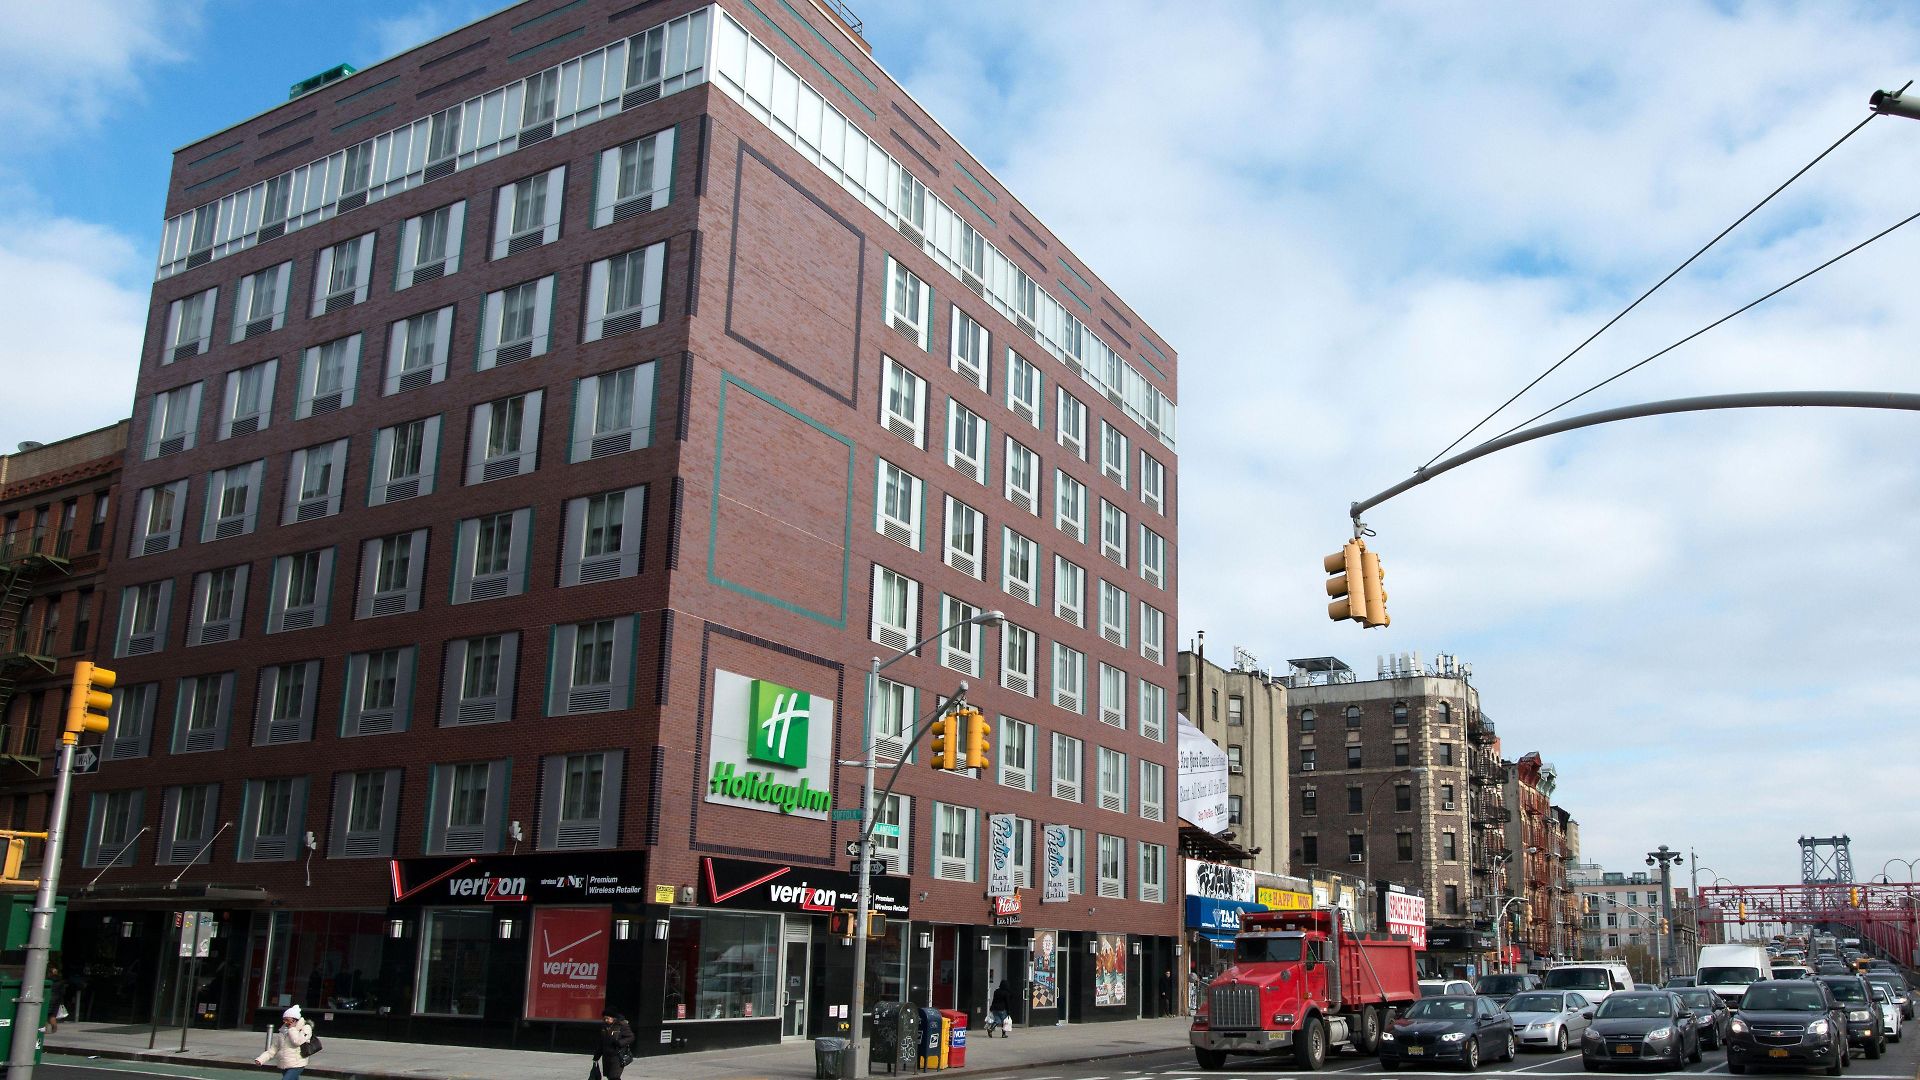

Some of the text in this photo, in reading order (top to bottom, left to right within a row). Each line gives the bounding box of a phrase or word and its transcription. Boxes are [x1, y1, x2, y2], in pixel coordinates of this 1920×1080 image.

[79, 753, 92, 766] WAY
[1190, 750, 1198, 772] York
[1199, 751, 1210, 768] Times
[709, 761, 832, 813] Holiday Inn
[833, 809, 857, 819] SUFFOLK
[450, 872, 527, 901] verizon
[589, 886, 641, 894] Wireless Retailer
[770, 882, 836, 911] verizon
[1273, 892, 1293, 907] HAPPY
[1298, 896, 1310, 908] WOK
[1390, 895, 1403, 919] SPACE
[1412, 899, 1424, 923] LEASE
[1221, 909, 1235, 923] TAJ
[544, 958, 599, 979] verizon
